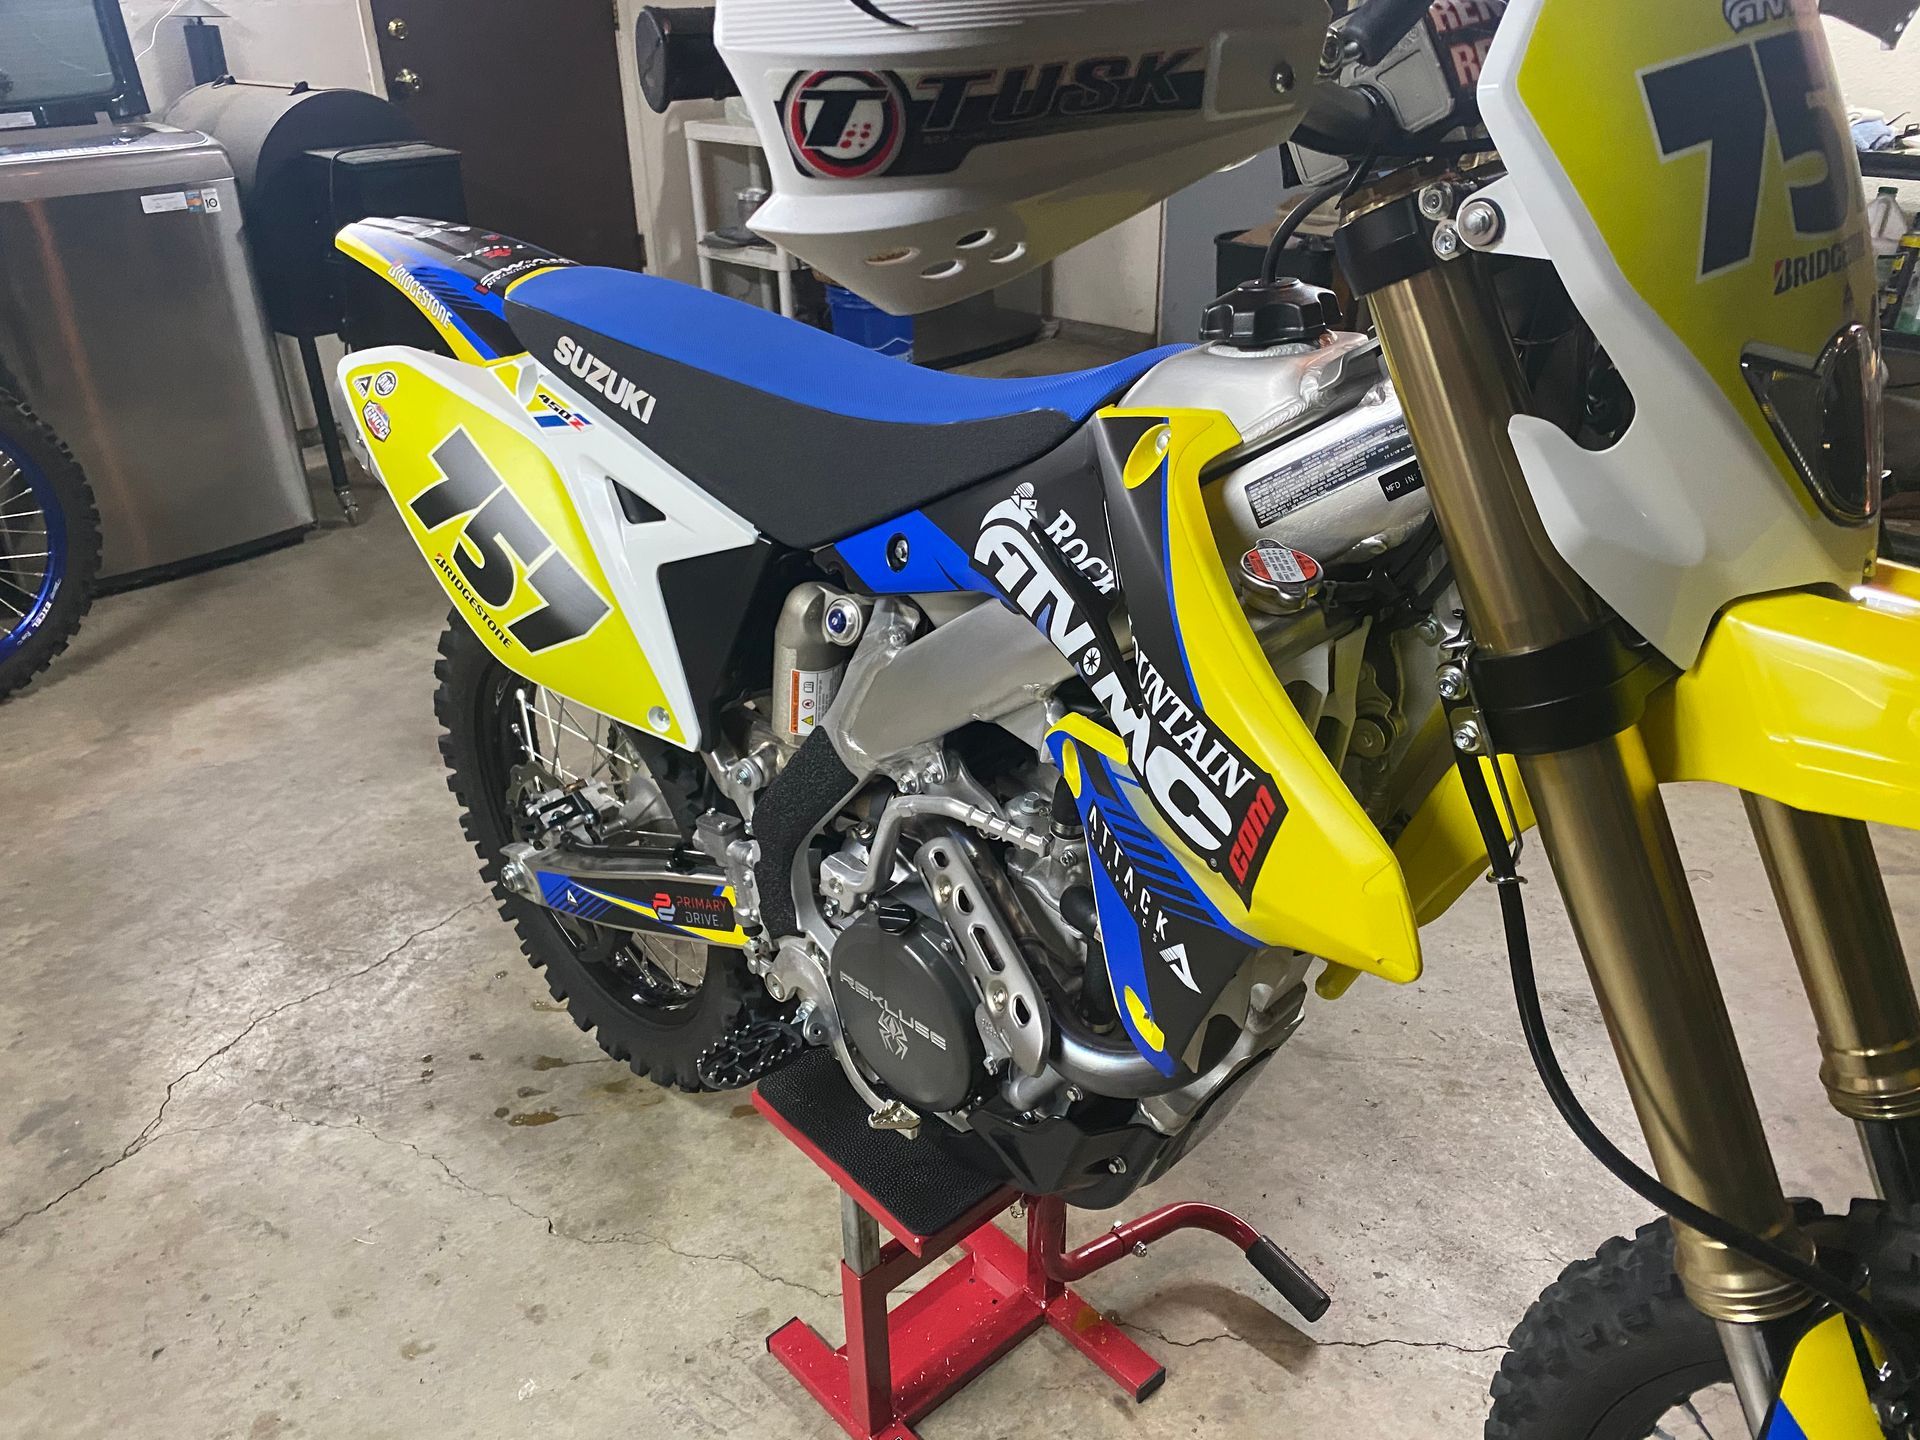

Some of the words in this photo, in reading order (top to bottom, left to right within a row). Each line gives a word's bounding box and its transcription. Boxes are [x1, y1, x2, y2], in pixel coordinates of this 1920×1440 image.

[916, 47, 1204, 132] TUSK
[387, 260, 453, 328] BRIDGESTONE
[553, 335, 657, 424] SUZUKI
[1385, 481, 1401, 494] MFD
[1044, 509, 1116, 595] ROCK
[31, 601, 53, 628] EXCEL
[434, 552, 512, 648] BRIDGESTONE
[675, 895, 727, 912] PRIMARY
[1088, 805, 1169, 941] ATTACK
[684, 911, 720, 927] DRIVE
[839, 970, 947, 1051] REKLUSE
